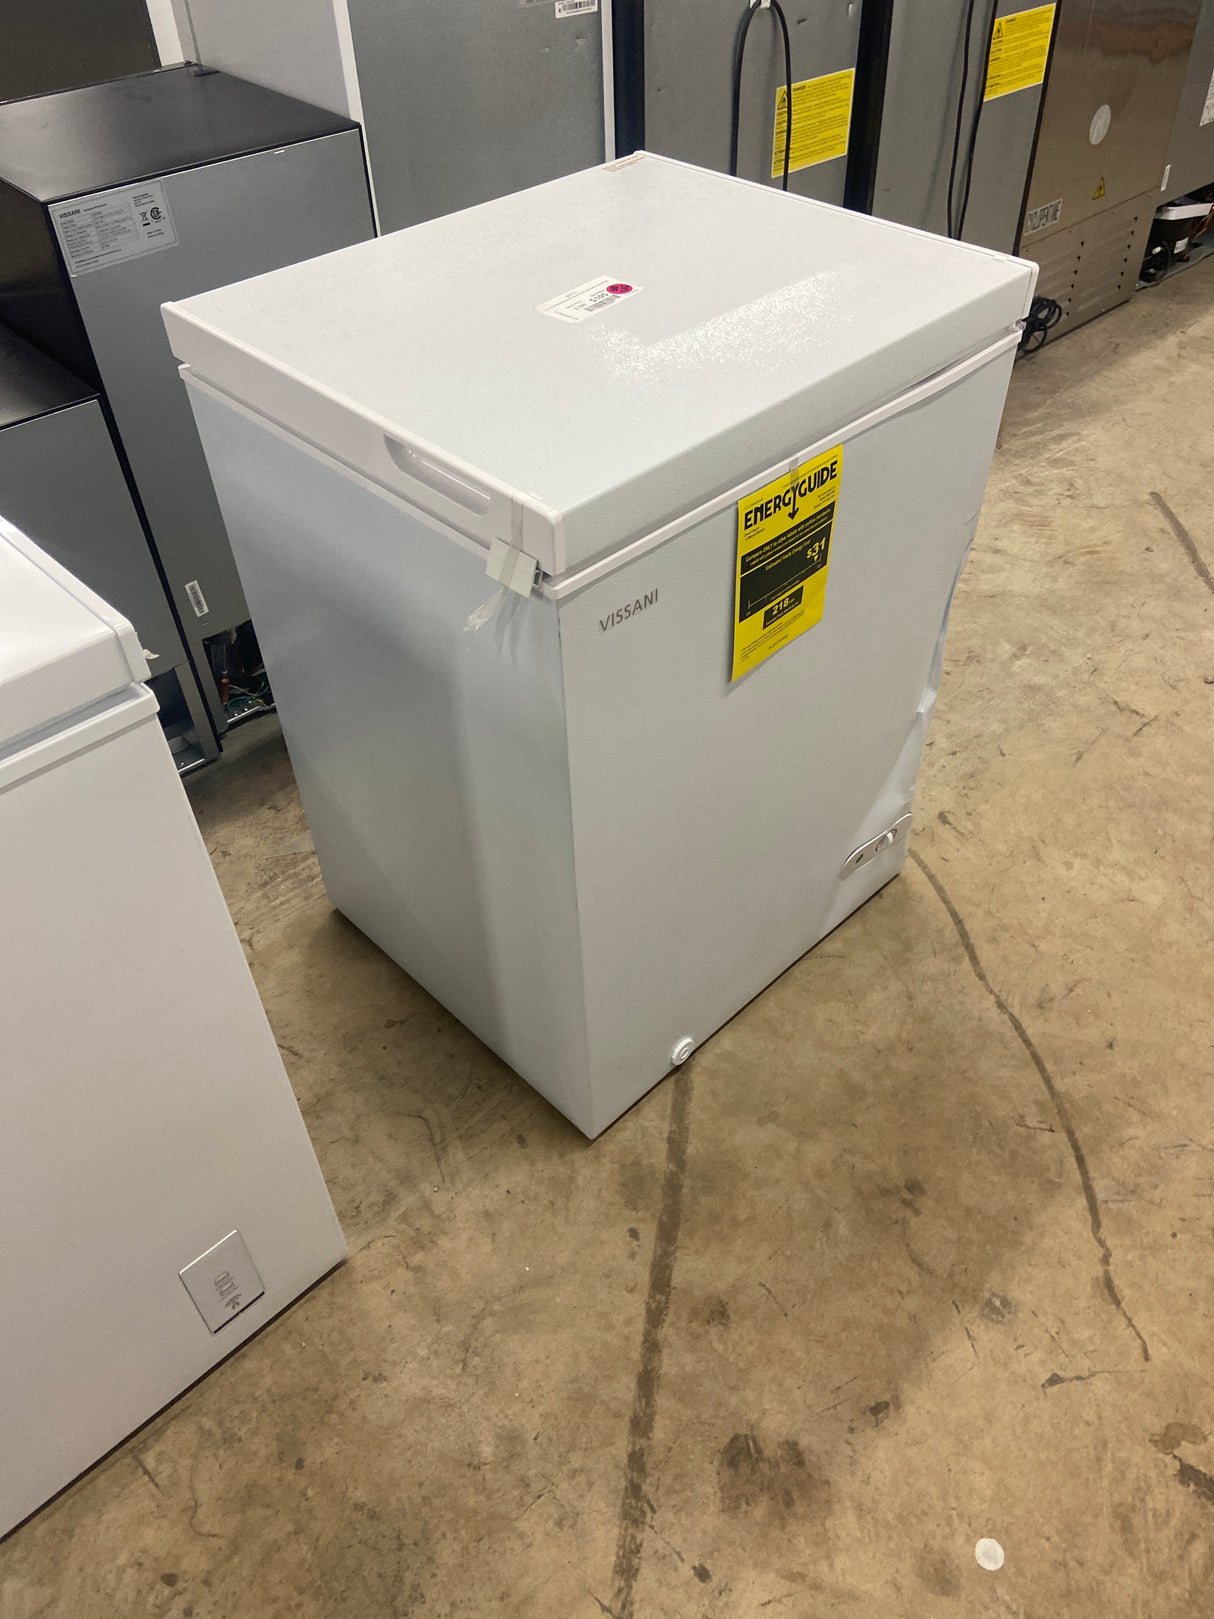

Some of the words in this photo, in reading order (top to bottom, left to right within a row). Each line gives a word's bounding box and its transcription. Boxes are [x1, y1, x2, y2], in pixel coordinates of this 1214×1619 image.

[59, 208, 81, 219] VISSANI
[744, 460, 838, 531] ENERGYGUIDE
[807, 536, 826, 559] $31
[600, 588, 658, 632] VISSANI
